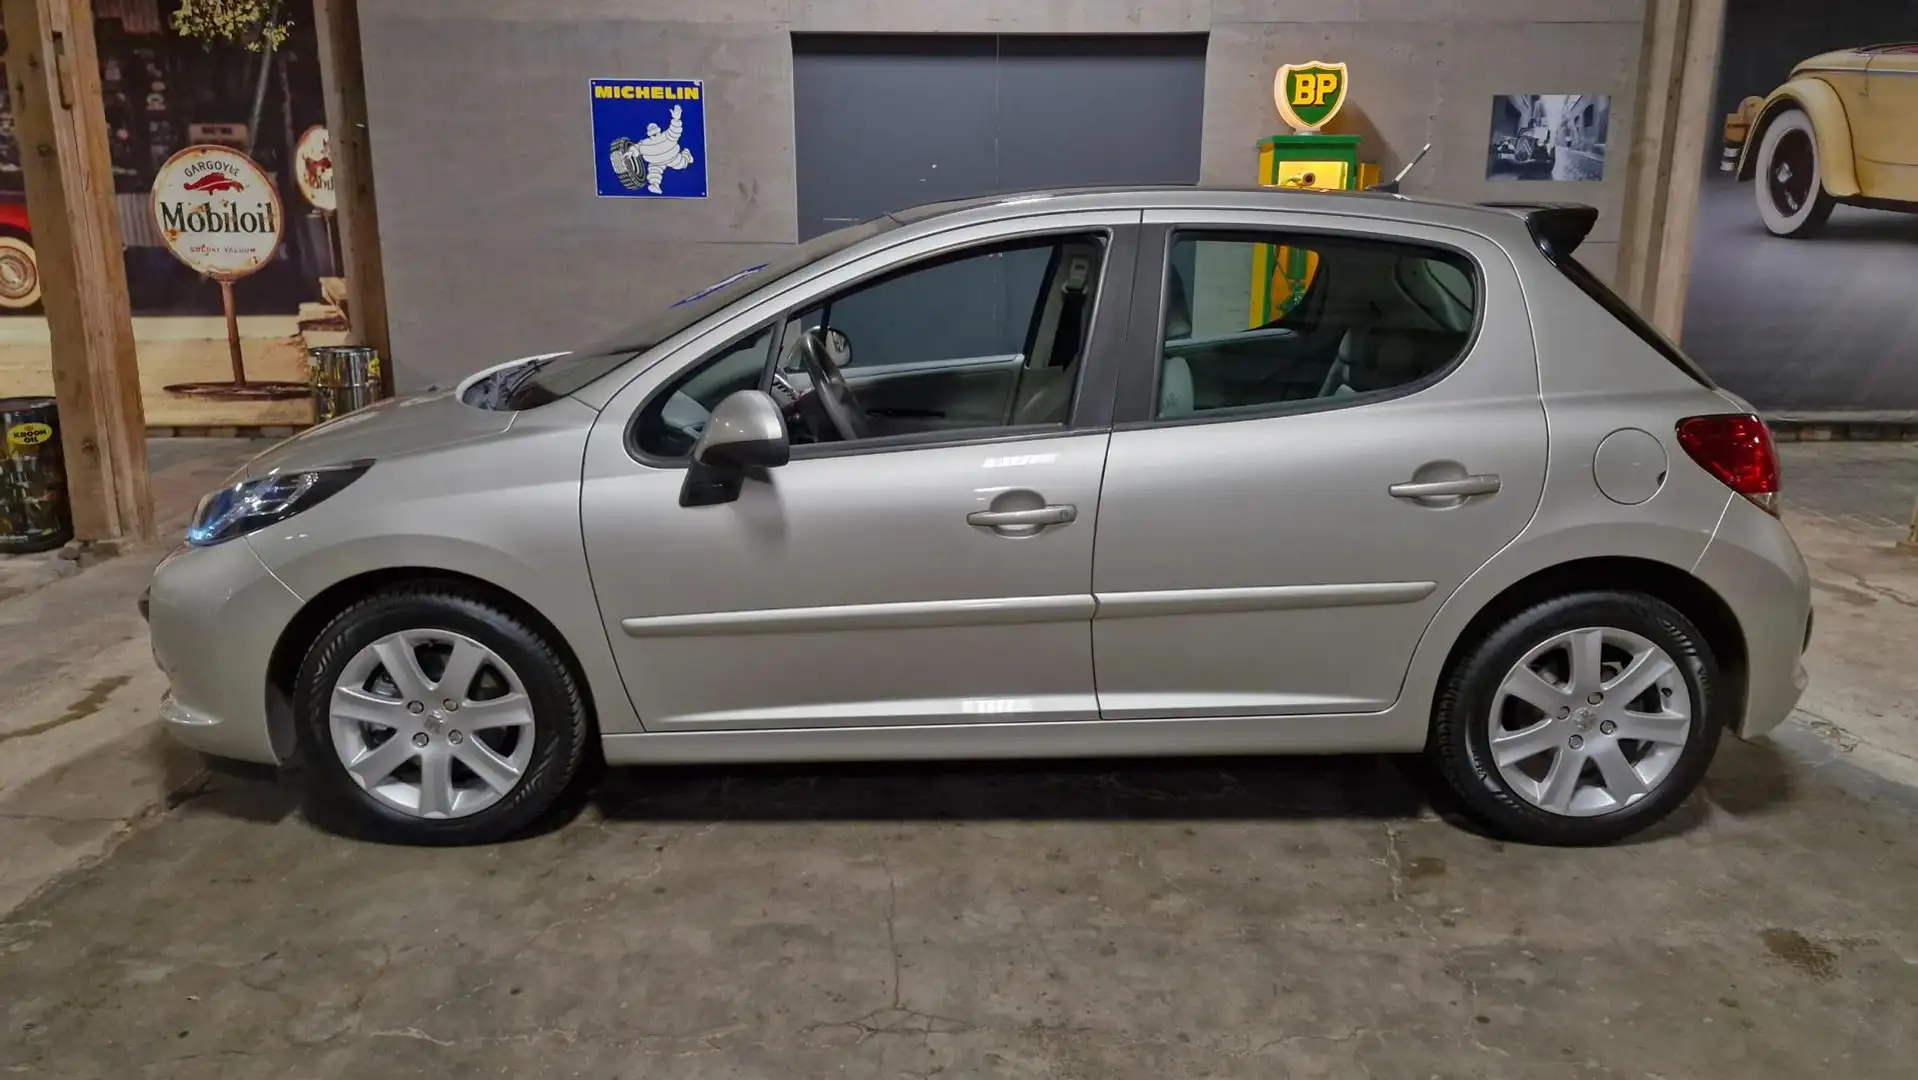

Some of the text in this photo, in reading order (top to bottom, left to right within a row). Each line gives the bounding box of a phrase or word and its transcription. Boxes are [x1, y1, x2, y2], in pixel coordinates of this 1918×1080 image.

[595, 86, 699, 99] MICHELIN
[1292, 73, 1337, 106] BP
[184, 160, 240, 177] GARGOYLE
[160, 201, 275, 233] Mobiloil
